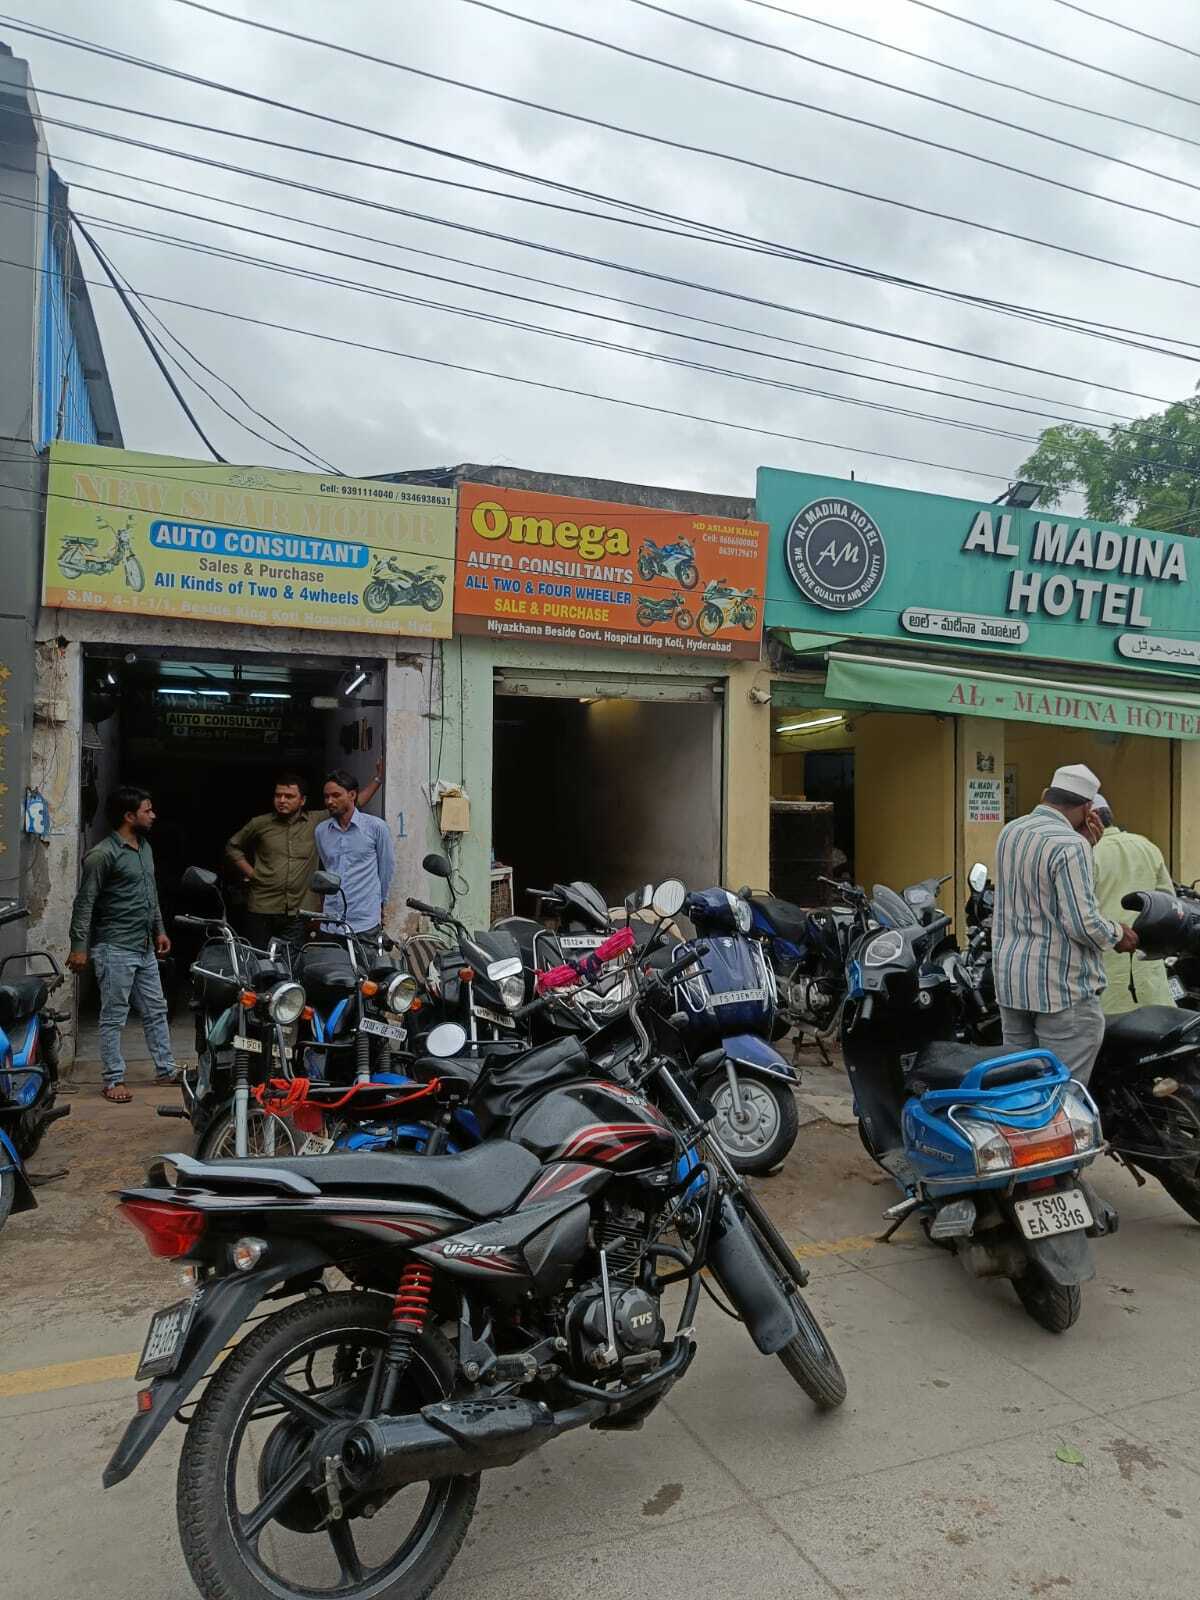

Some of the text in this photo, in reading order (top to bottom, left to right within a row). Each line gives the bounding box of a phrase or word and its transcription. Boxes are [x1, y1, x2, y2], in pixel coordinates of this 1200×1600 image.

[320, 483, 339, 493] Cell:
[72, 473, 439, 545] NEW STAR MOTOR
[471, 501, 631, 561] Omega
[795, 503, 879, 547] AL MADINA HOTEL
[156, 525, 364, 564] AUTO CONSULTANT
[816, 540, 859, 567] AM
[963, 510, 1188, 583] AL MADINA
[199, 556, 325, 584] Sales & Purchase
[467, 551, 633, 585] AUTO CONSULTANTS
[797, 562, 816, 588] SERVE
[814, 586, 846, 603] QUALITY
[847, 591, 862, 602] AND
[860, 554, 881, 593] QUANTITY
[154, 572, 360, 606] All Kinds of Two & 4wheels
[465, 576, 632, 605] ALL TWO & FOUR WHEELER
[1008, 571, 1152, 627] HOTEL
[494, 598, 610, 622] SALE & PURCHASE
[544, 625, 576, 639] Beside
[578, 628, 602, 642] Govt.
[604, 631, 641, 647] Hospital
[643, 635, 663, 649] King
[665, 637, 685, 650] Koti,
[686, 639, 732, 653] Hyderabad
[168, 713, 201, 726] AUTO
[947, 682, 985, 707] AL
[1012, 690, 1118, 725] MADINA
[1126, 704, 1200, 737] HOTE
[1032, 1196, 1067, 1217] TS10
[1028, 1209, 1085, 1235] EA 3316
[443, 1243, 506, 1258] Victor
[630, 1311, 653, 1329] TVS
